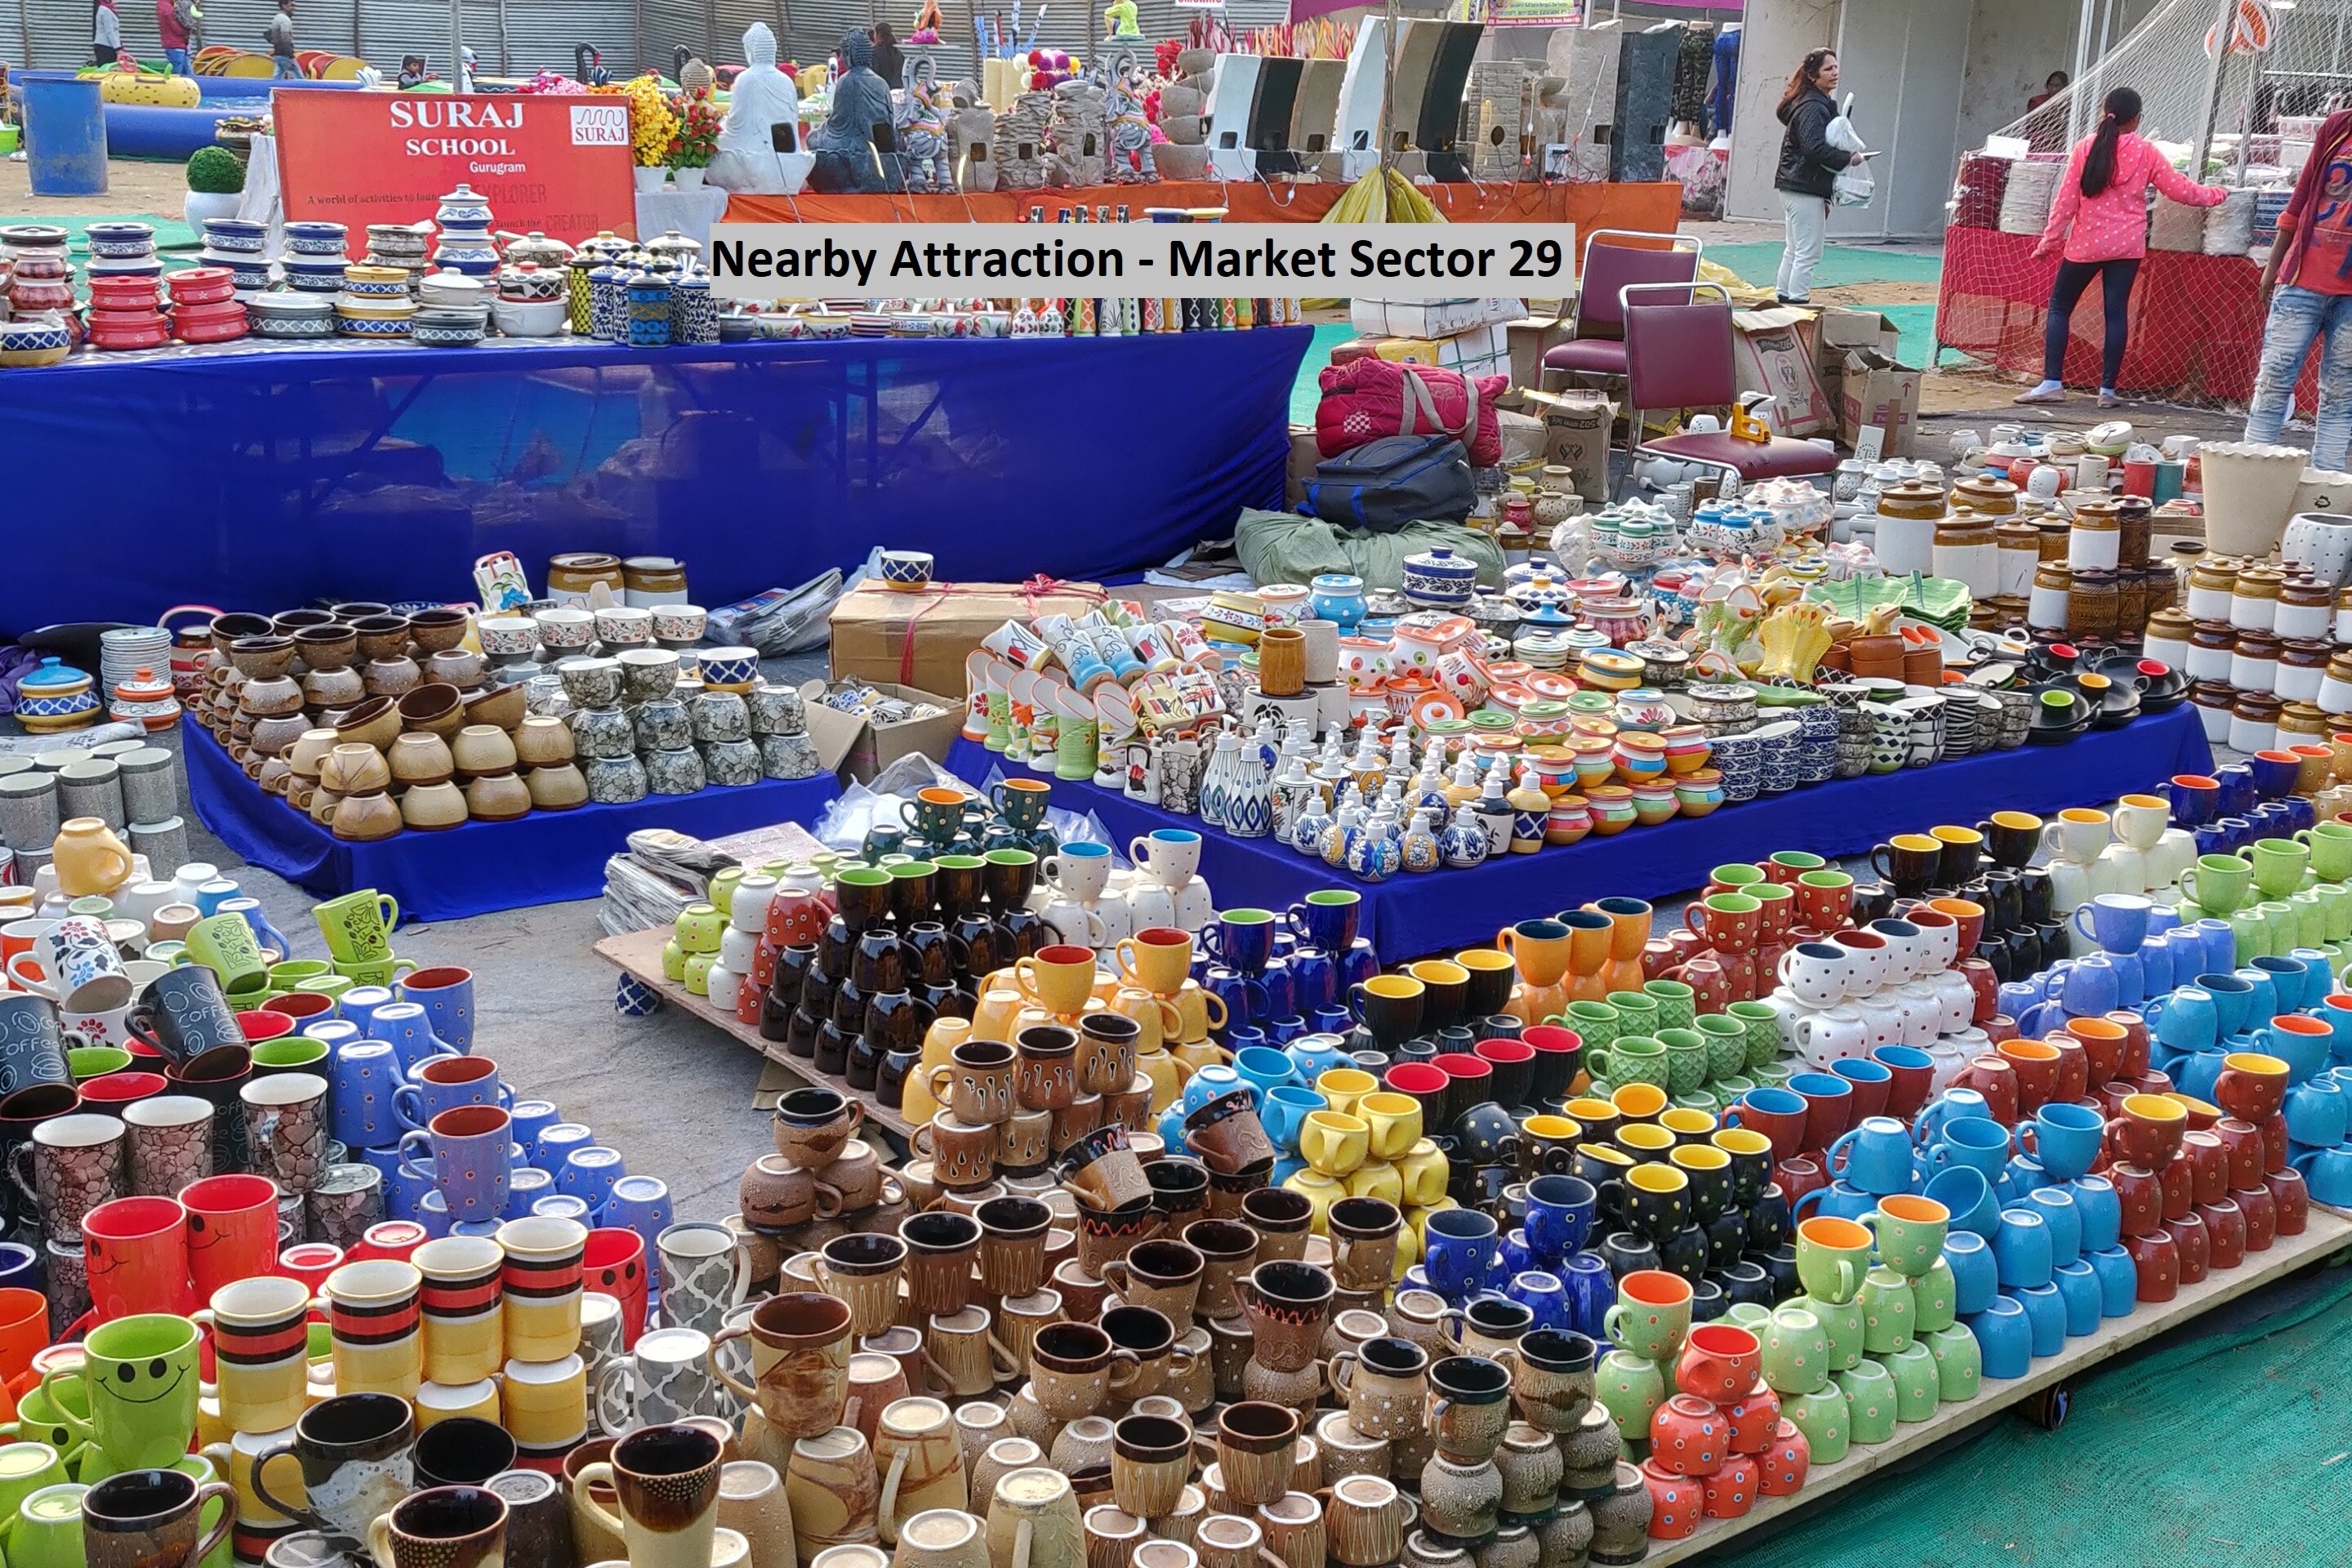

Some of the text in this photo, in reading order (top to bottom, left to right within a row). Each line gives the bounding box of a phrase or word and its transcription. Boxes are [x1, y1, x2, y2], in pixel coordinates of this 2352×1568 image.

[390, 100, 526, 128] SURAJ
[575, 127, 626, 142] SURAJ
[406, 138, 516, 156] SCHOOL
[470, 161, 526, 175] Gurugram
[308, 195, 315, 204] A
[316, 194, 346, 204] world
[348, 194, 359, 203] of
[360, 193, 403, 203] activities
[416, 193, 439, 202] laun
